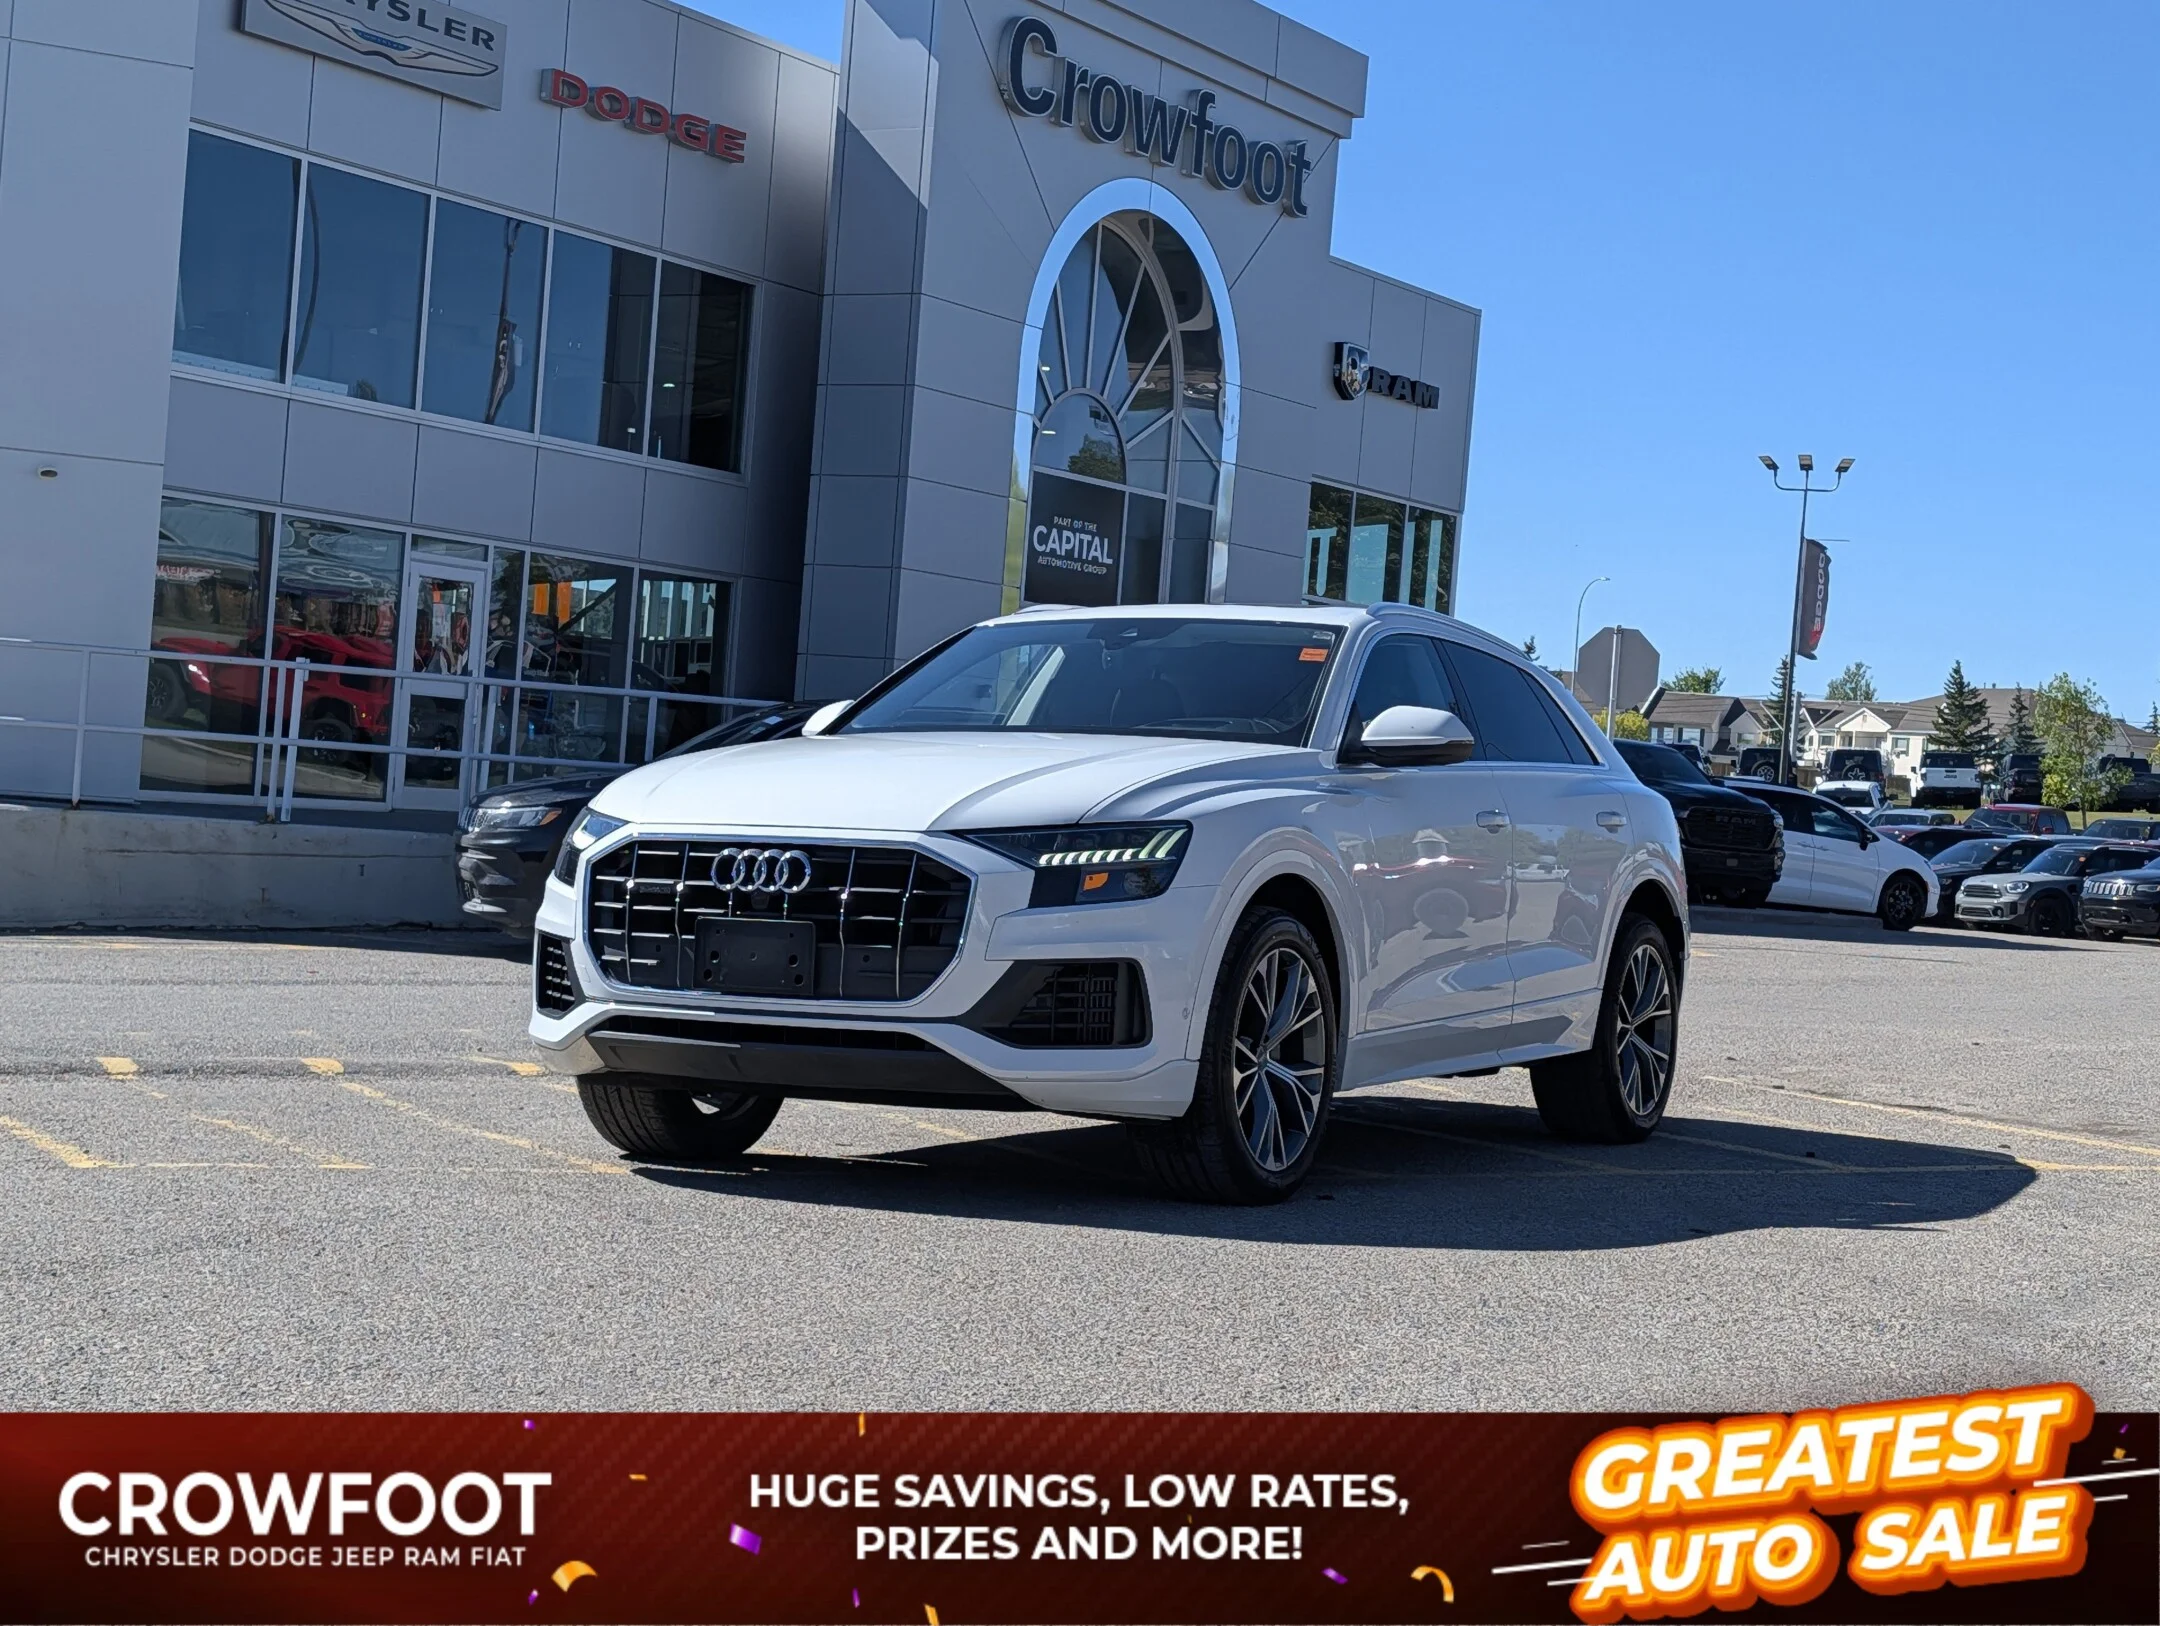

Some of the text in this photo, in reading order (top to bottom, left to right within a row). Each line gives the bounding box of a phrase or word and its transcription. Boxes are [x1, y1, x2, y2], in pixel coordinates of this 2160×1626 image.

[345, 0, 496, 51] YSLER
[541, 68, 747, 163] DODGE
[1000, 15, 1312, 218] Crowfoot
[1368, 366, 1440, 409] RAM
[1033, 525, 1113, 565] CAPITAL
[1053, 515, 1098, 532] PART OF THE
[1037, 555, 1108, 575] AUTOMOTIVE GROUP
[1813, 552, 1826, 631] DODGE
